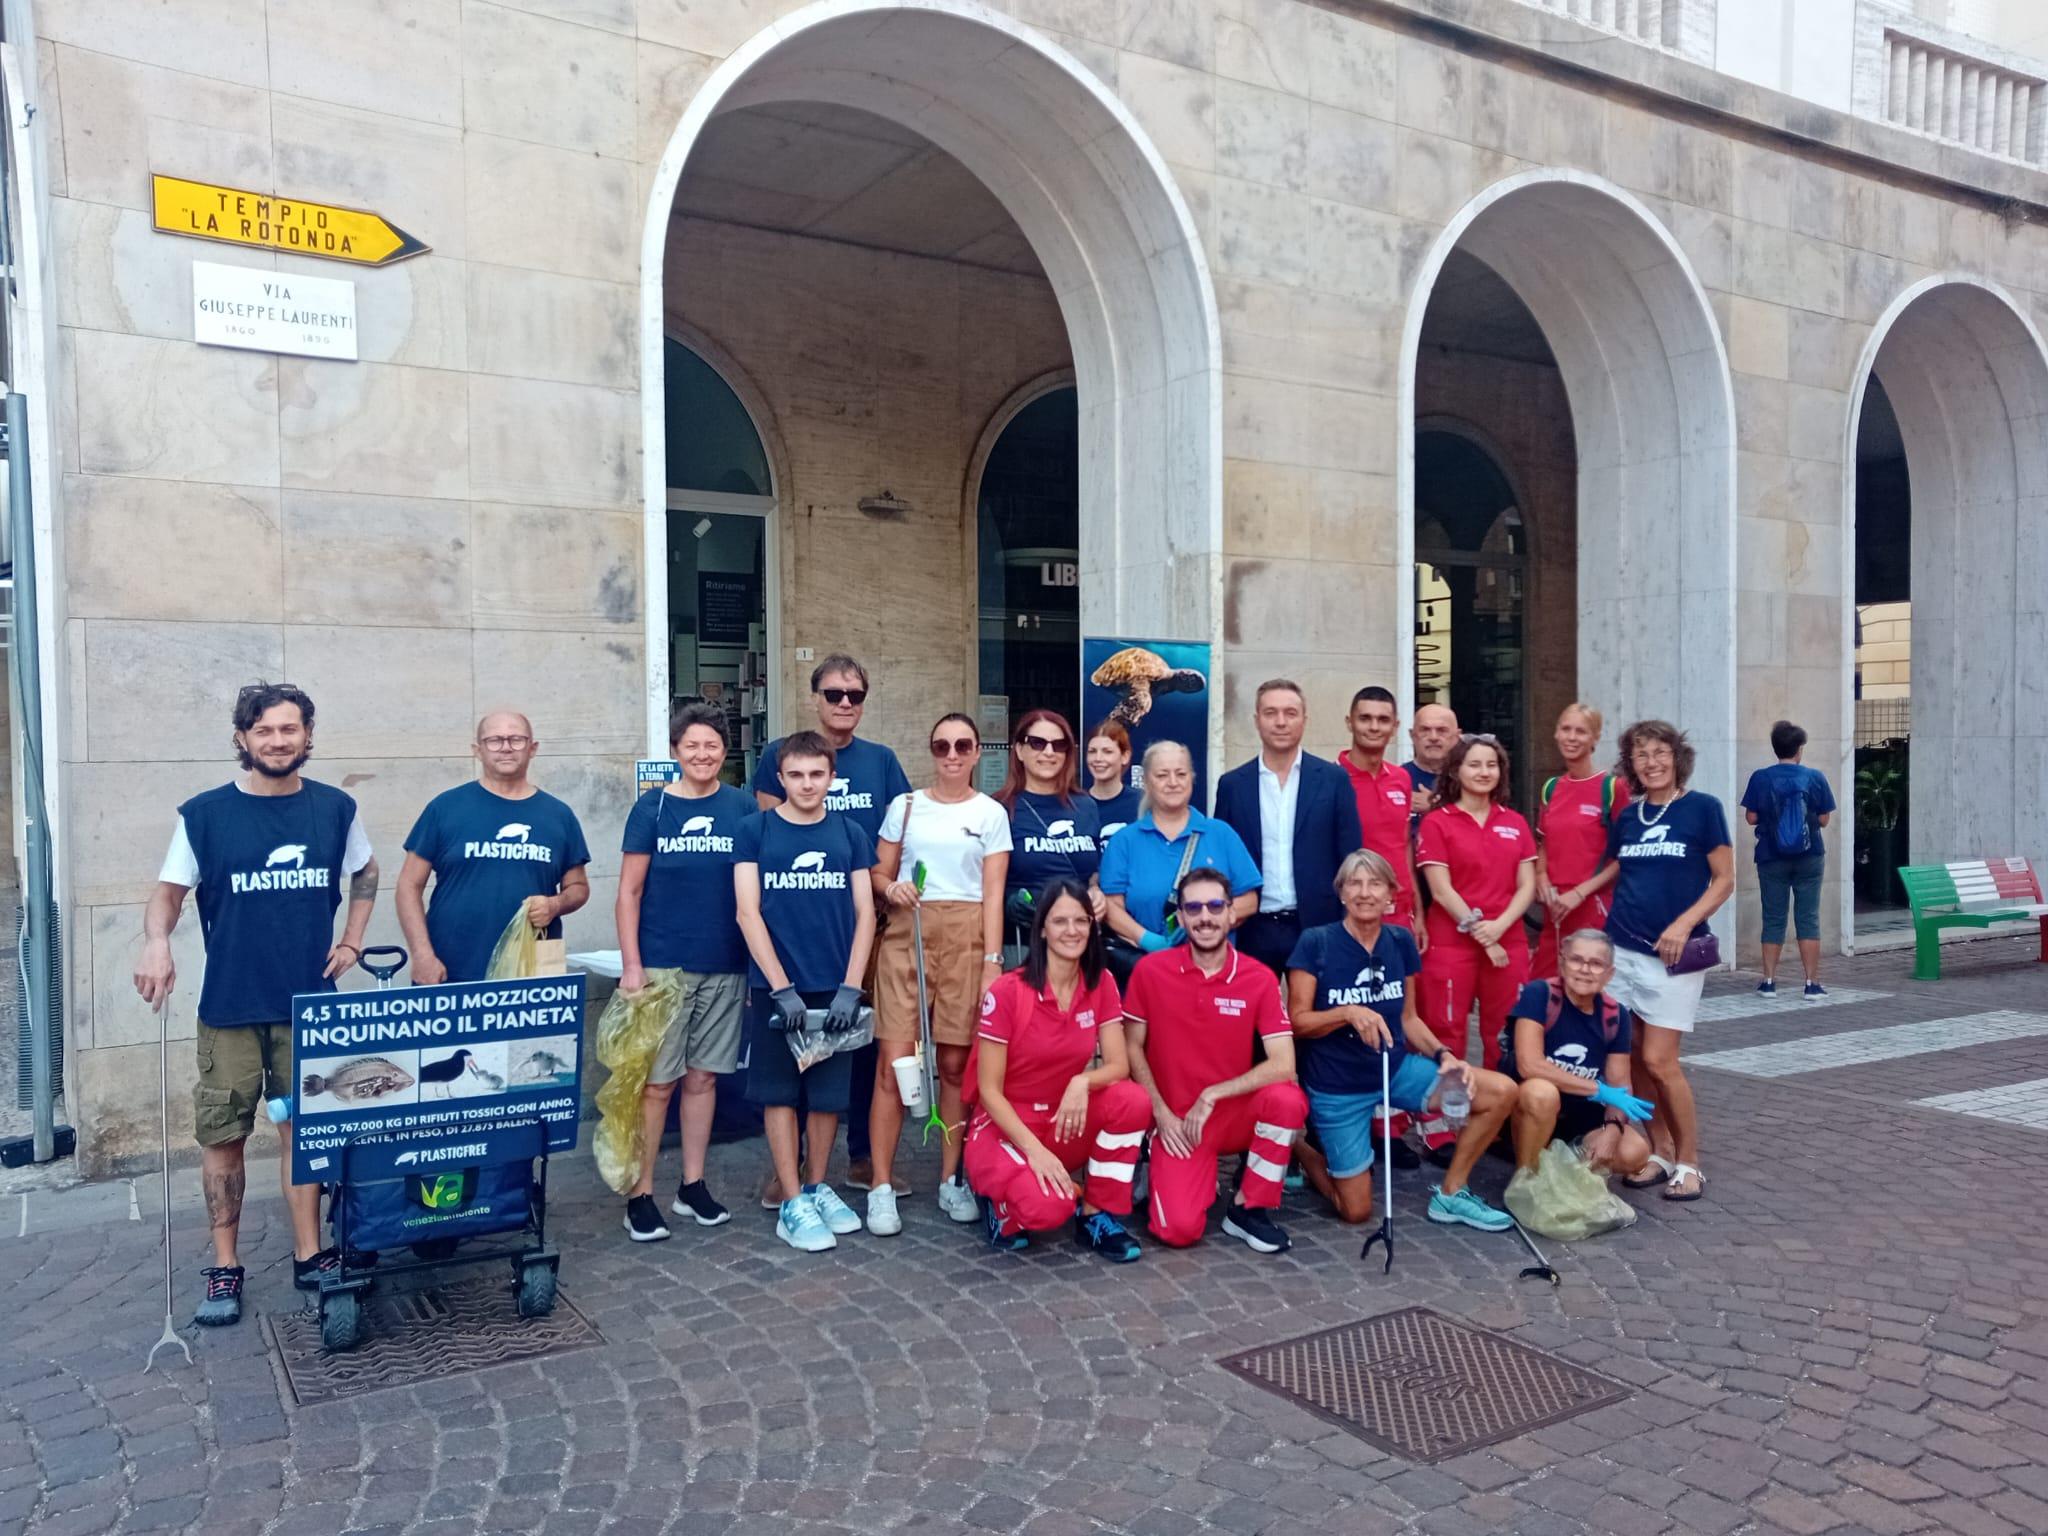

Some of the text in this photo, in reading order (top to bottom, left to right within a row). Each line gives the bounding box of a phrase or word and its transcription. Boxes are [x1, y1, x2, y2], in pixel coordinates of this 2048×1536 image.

[217, 193, 328, 228] TEMPIO
[263, 283, 291, 300] VIA
[200, 299, 353, 329] GIUSEPPE LAURENTI
[1041, 562, 1079, 587] LIB
[464, 841, 551, 863] PLASTICFREE
[656, 836, 734, 853] PLASTICFREE
[231, 868, 329, 893] PLASTICFREE
[764, 871, 846, 889] PLASTICFREE
[301, 984, 578, 1024] 4,5 TRILIONI DI MOZZICONI
[302, 1018, 451, 1047] INQUINANO
[457, 1015, 477, 1033] IL
[300, 1097, 575, 1137] SONO 767.000 KG DI RIFIUTI TOSSICI OGNI ANNO.
[300, 1133, 394, 1151] L'EQUIVENTE,
[396, 1132, 409, 1142] IN
[412, 1127, 444, 1139] PESO,
[446, 1126, 458, 1135] DI
[420, 1143, 488, 1163] PLASTICFREE
